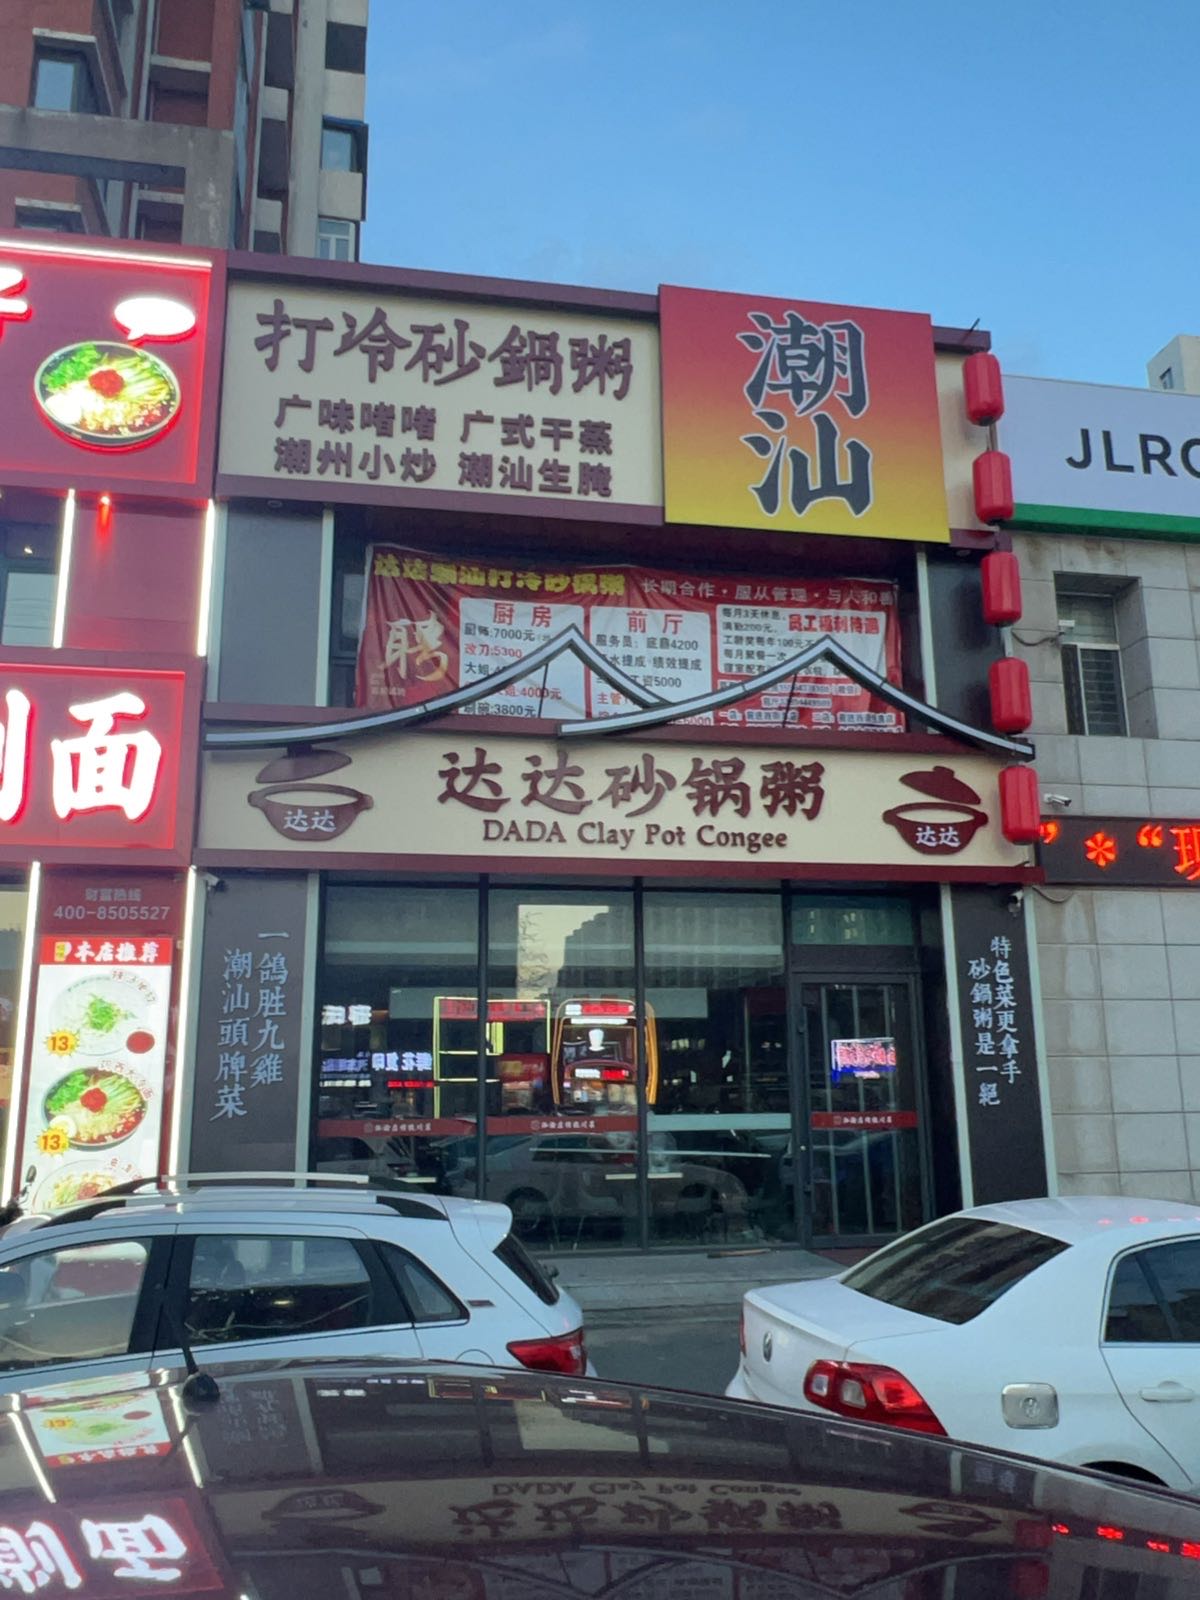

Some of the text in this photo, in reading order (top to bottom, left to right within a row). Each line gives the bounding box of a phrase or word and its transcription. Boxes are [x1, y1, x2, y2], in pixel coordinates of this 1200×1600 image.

[254, 298, 635, 401] 打冷砂鍋粥
[274, 394, 614, 456] 广味啫啫 广式干蒸
[736, 310, 875, 519] 潮汕
[273, 436, 614, 498] 潮州小炒 潮汕生腌
[493, 602, 553, 629] 厨房
[626, 610, 684, 636] 前厅
[385, 609, 450, 683] 聘
[437, 747, 826, 821] 达达砂锅粥
[282, 808, 338, 833] 达达
[482, 819, 788, 854] DADA Clay Pot Congee
[914, 825, 962, 848] 达达
[53, 904, 171, 921] 400-8505527
[990, 935, 1023, 1085] 特色菜更拿手
[49, 1035, 70, 1052] 13
[209, 947, 253, 1123] 潮汕頭牌菜
[41, 1134, 62, 1151] 13
